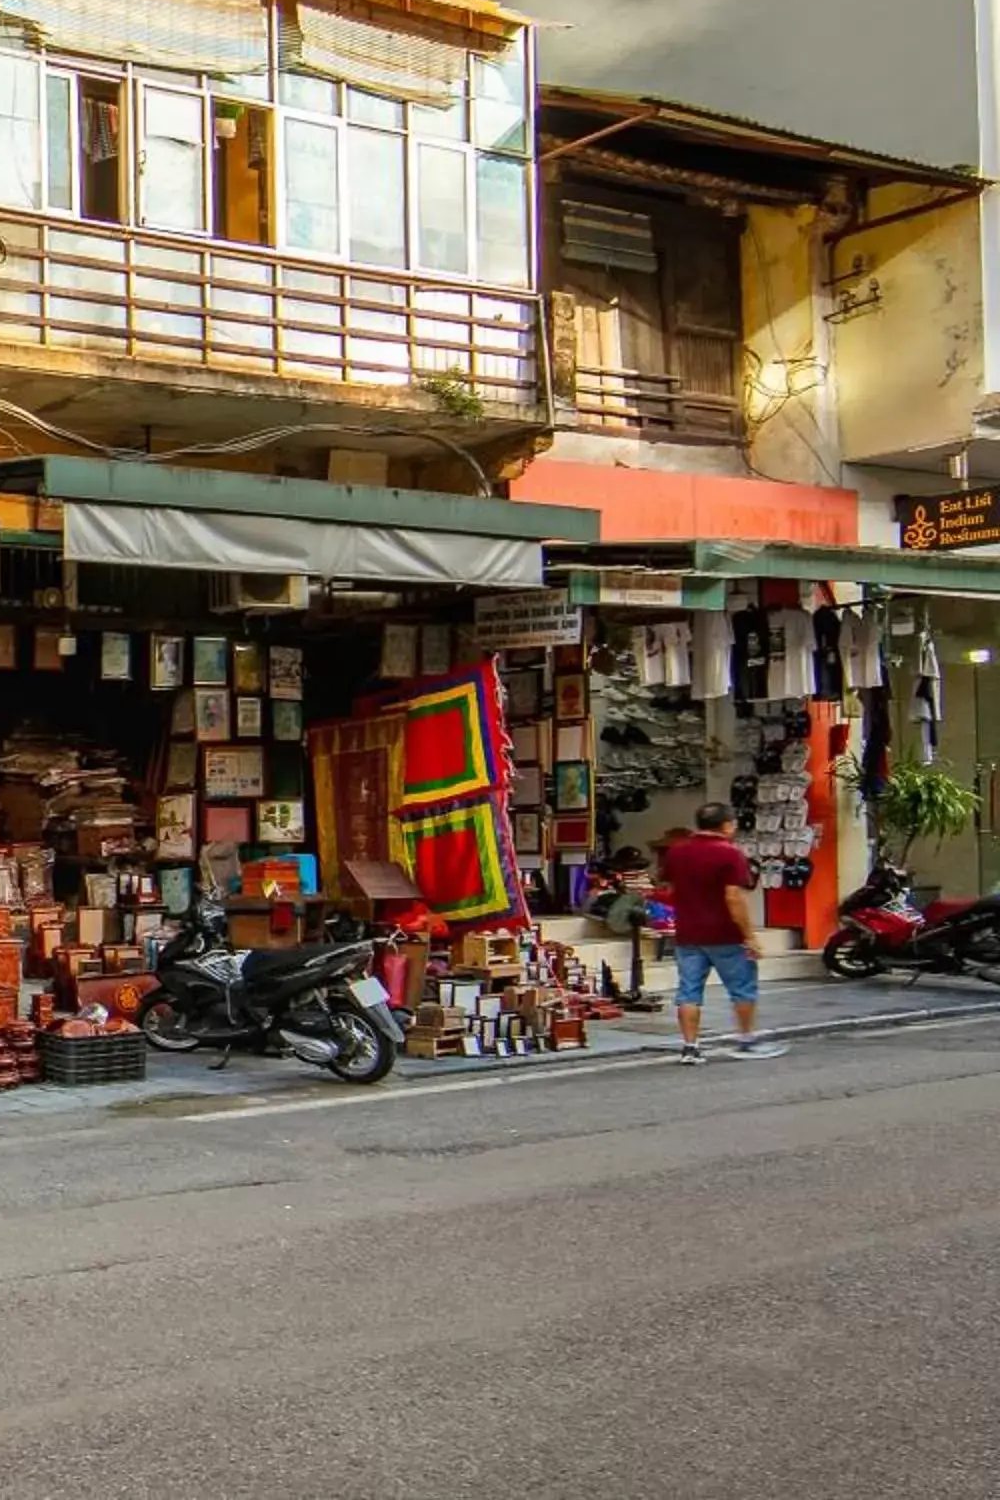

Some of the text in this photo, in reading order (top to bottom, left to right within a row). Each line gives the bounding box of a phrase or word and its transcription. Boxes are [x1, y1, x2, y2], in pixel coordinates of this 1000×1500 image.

[940, 492, 992, 513] Eat List
[940, 514, 985, 529] Indian
